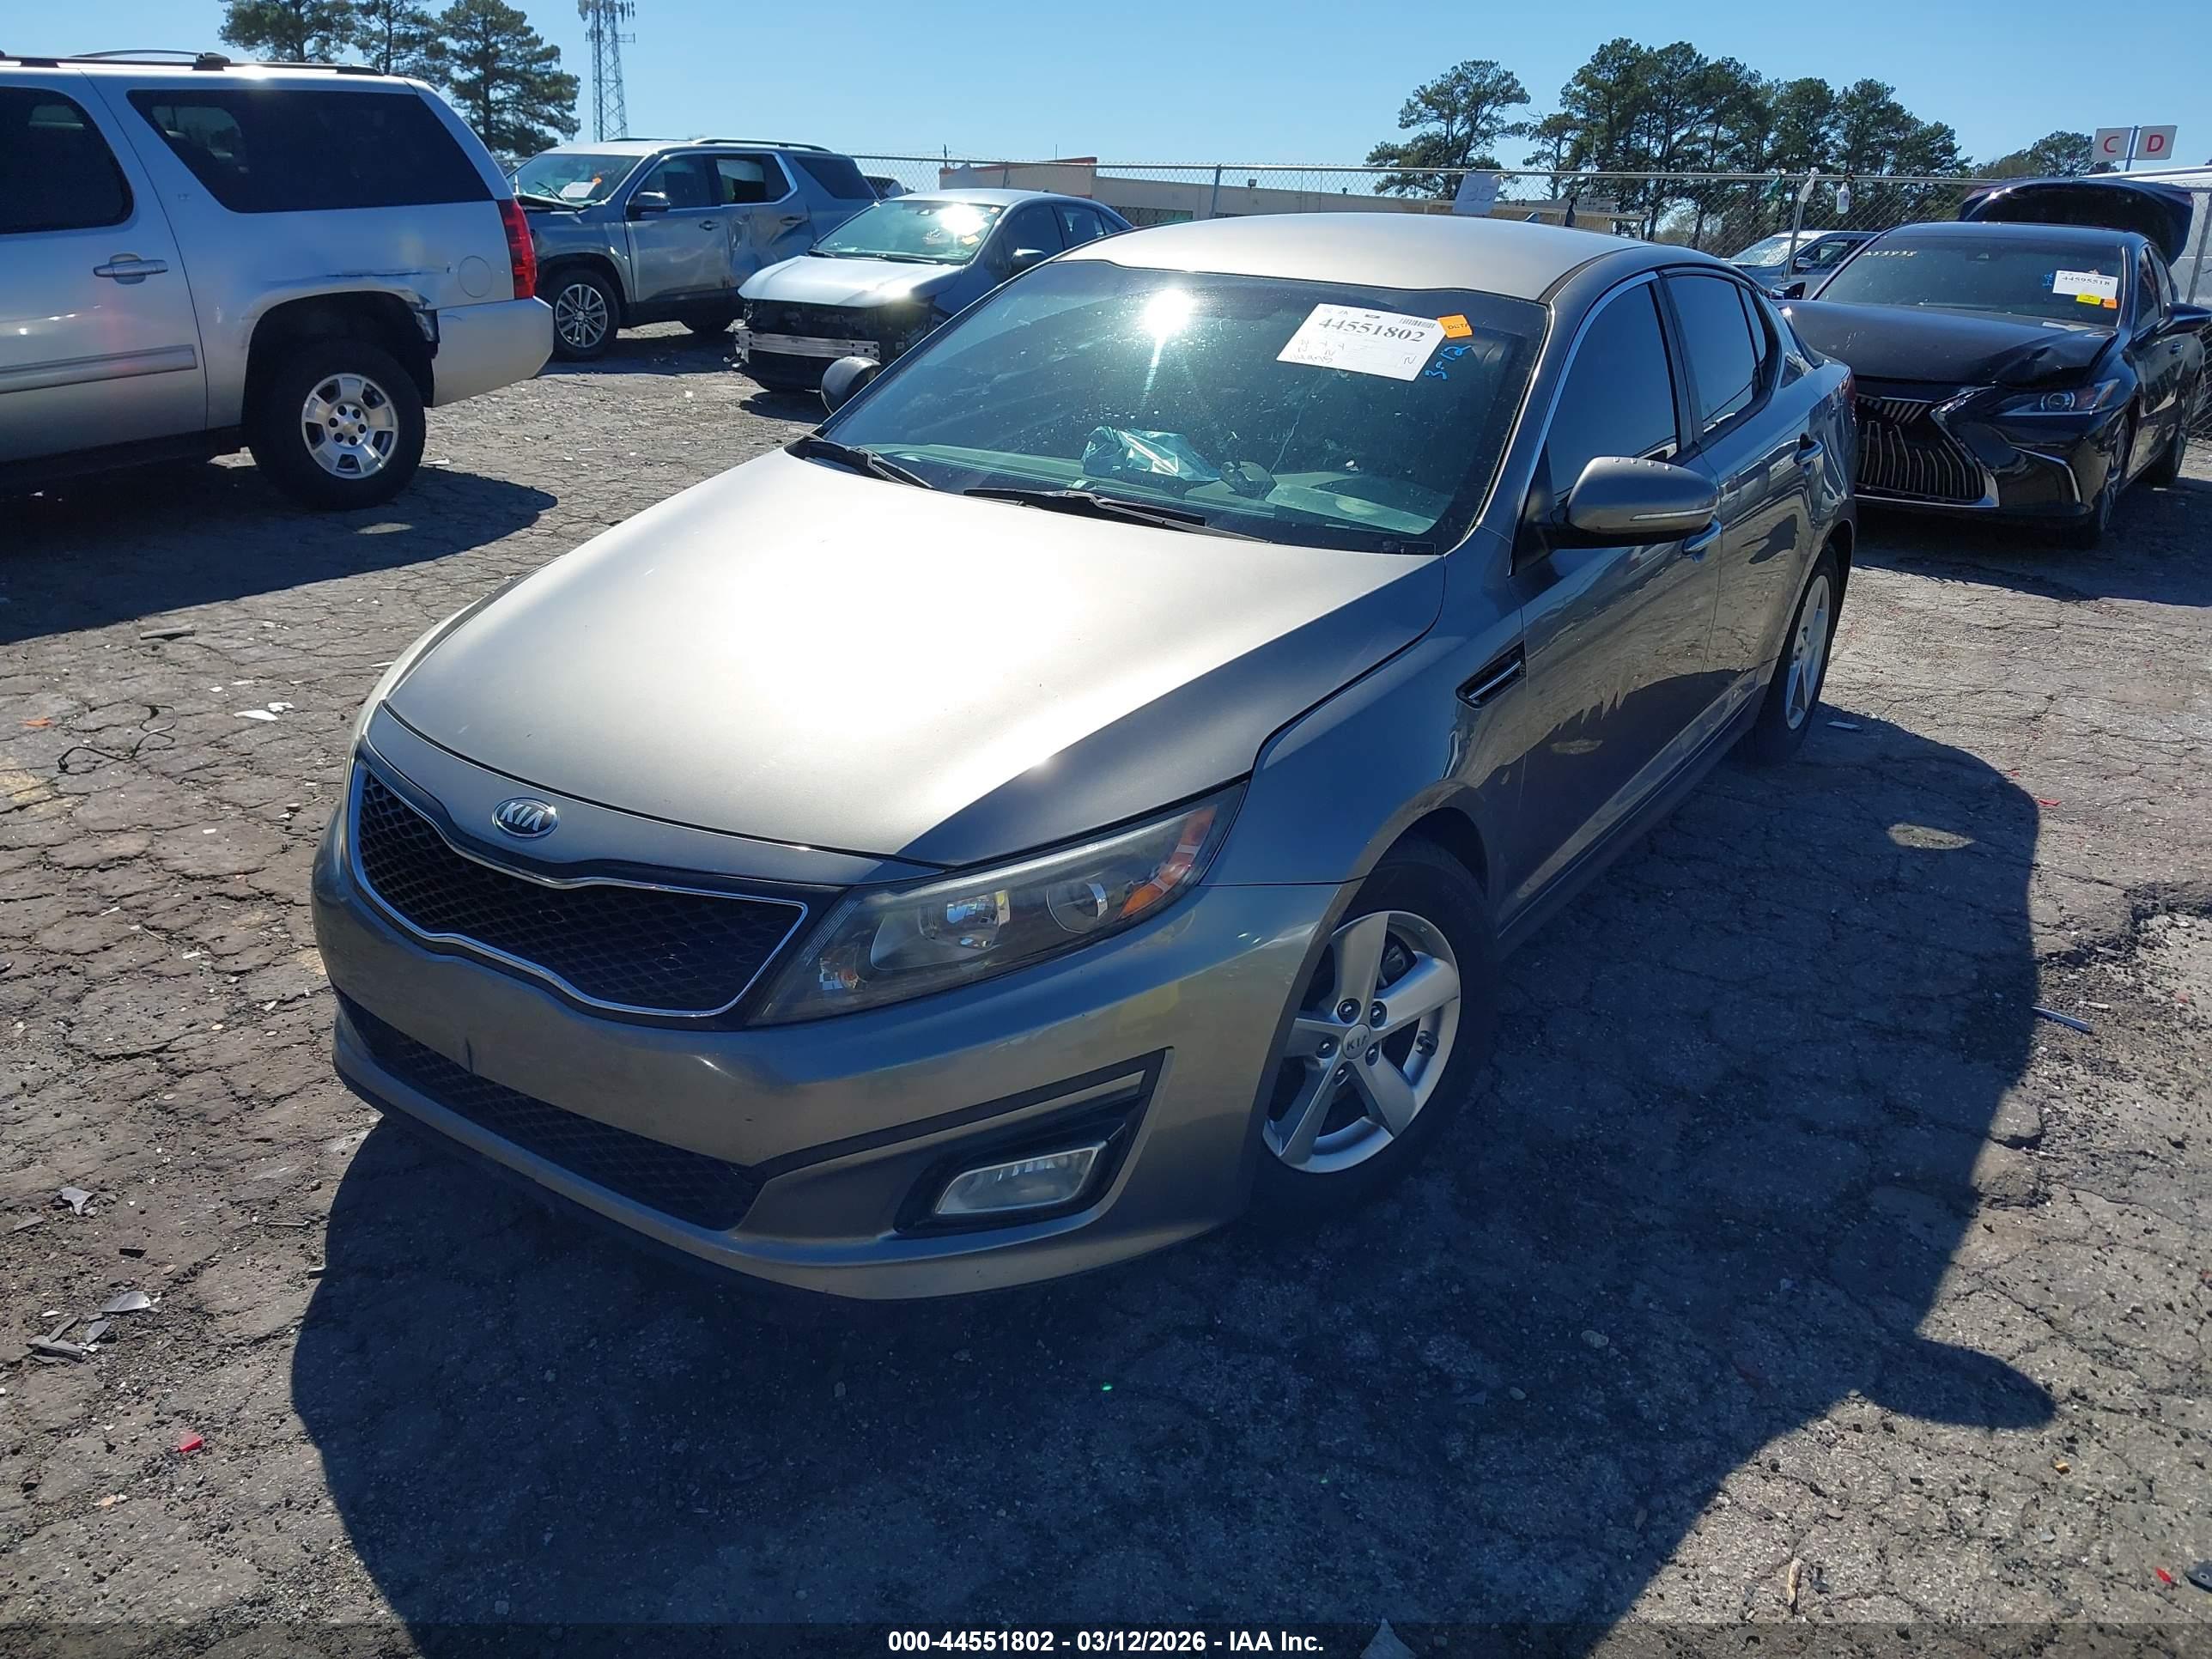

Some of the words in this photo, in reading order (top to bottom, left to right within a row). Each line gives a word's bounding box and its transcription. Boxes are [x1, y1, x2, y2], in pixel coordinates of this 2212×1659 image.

[2103, 136, 2121, 154] C
[2147, 134, 2165, 153] D
[1318, 318, 1425, 343] 44551802
[499, 802, 544, 831] KIA
